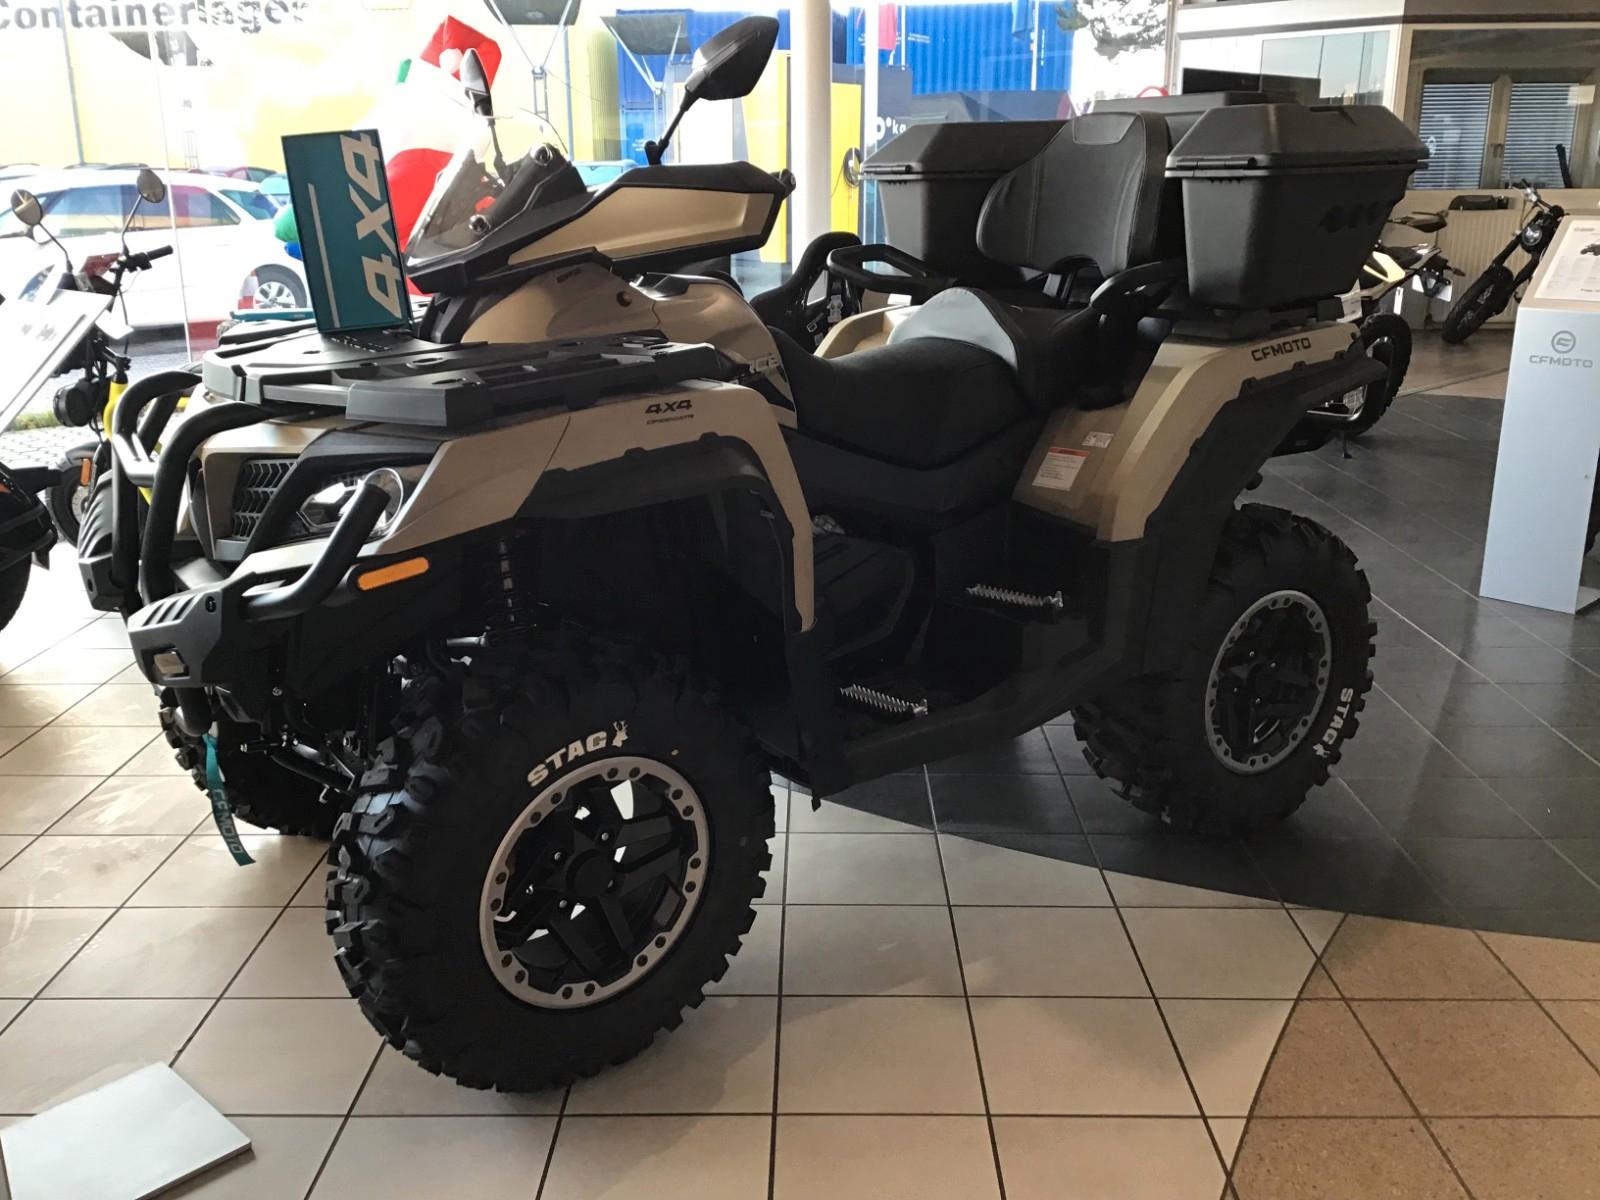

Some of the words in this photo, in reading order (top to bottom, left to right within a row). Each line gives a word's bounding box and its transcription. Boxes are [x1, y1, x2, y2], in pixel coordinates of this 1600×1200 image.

[1251, 337, 1312, 362] CFMOTO
[1529, 354, 1594, 368] CFMOTO
[1322, 687, 1354, 745] STAG
[527, 730, 608, 787] STAG
[212, 788, 245, 854] CFMOTO
